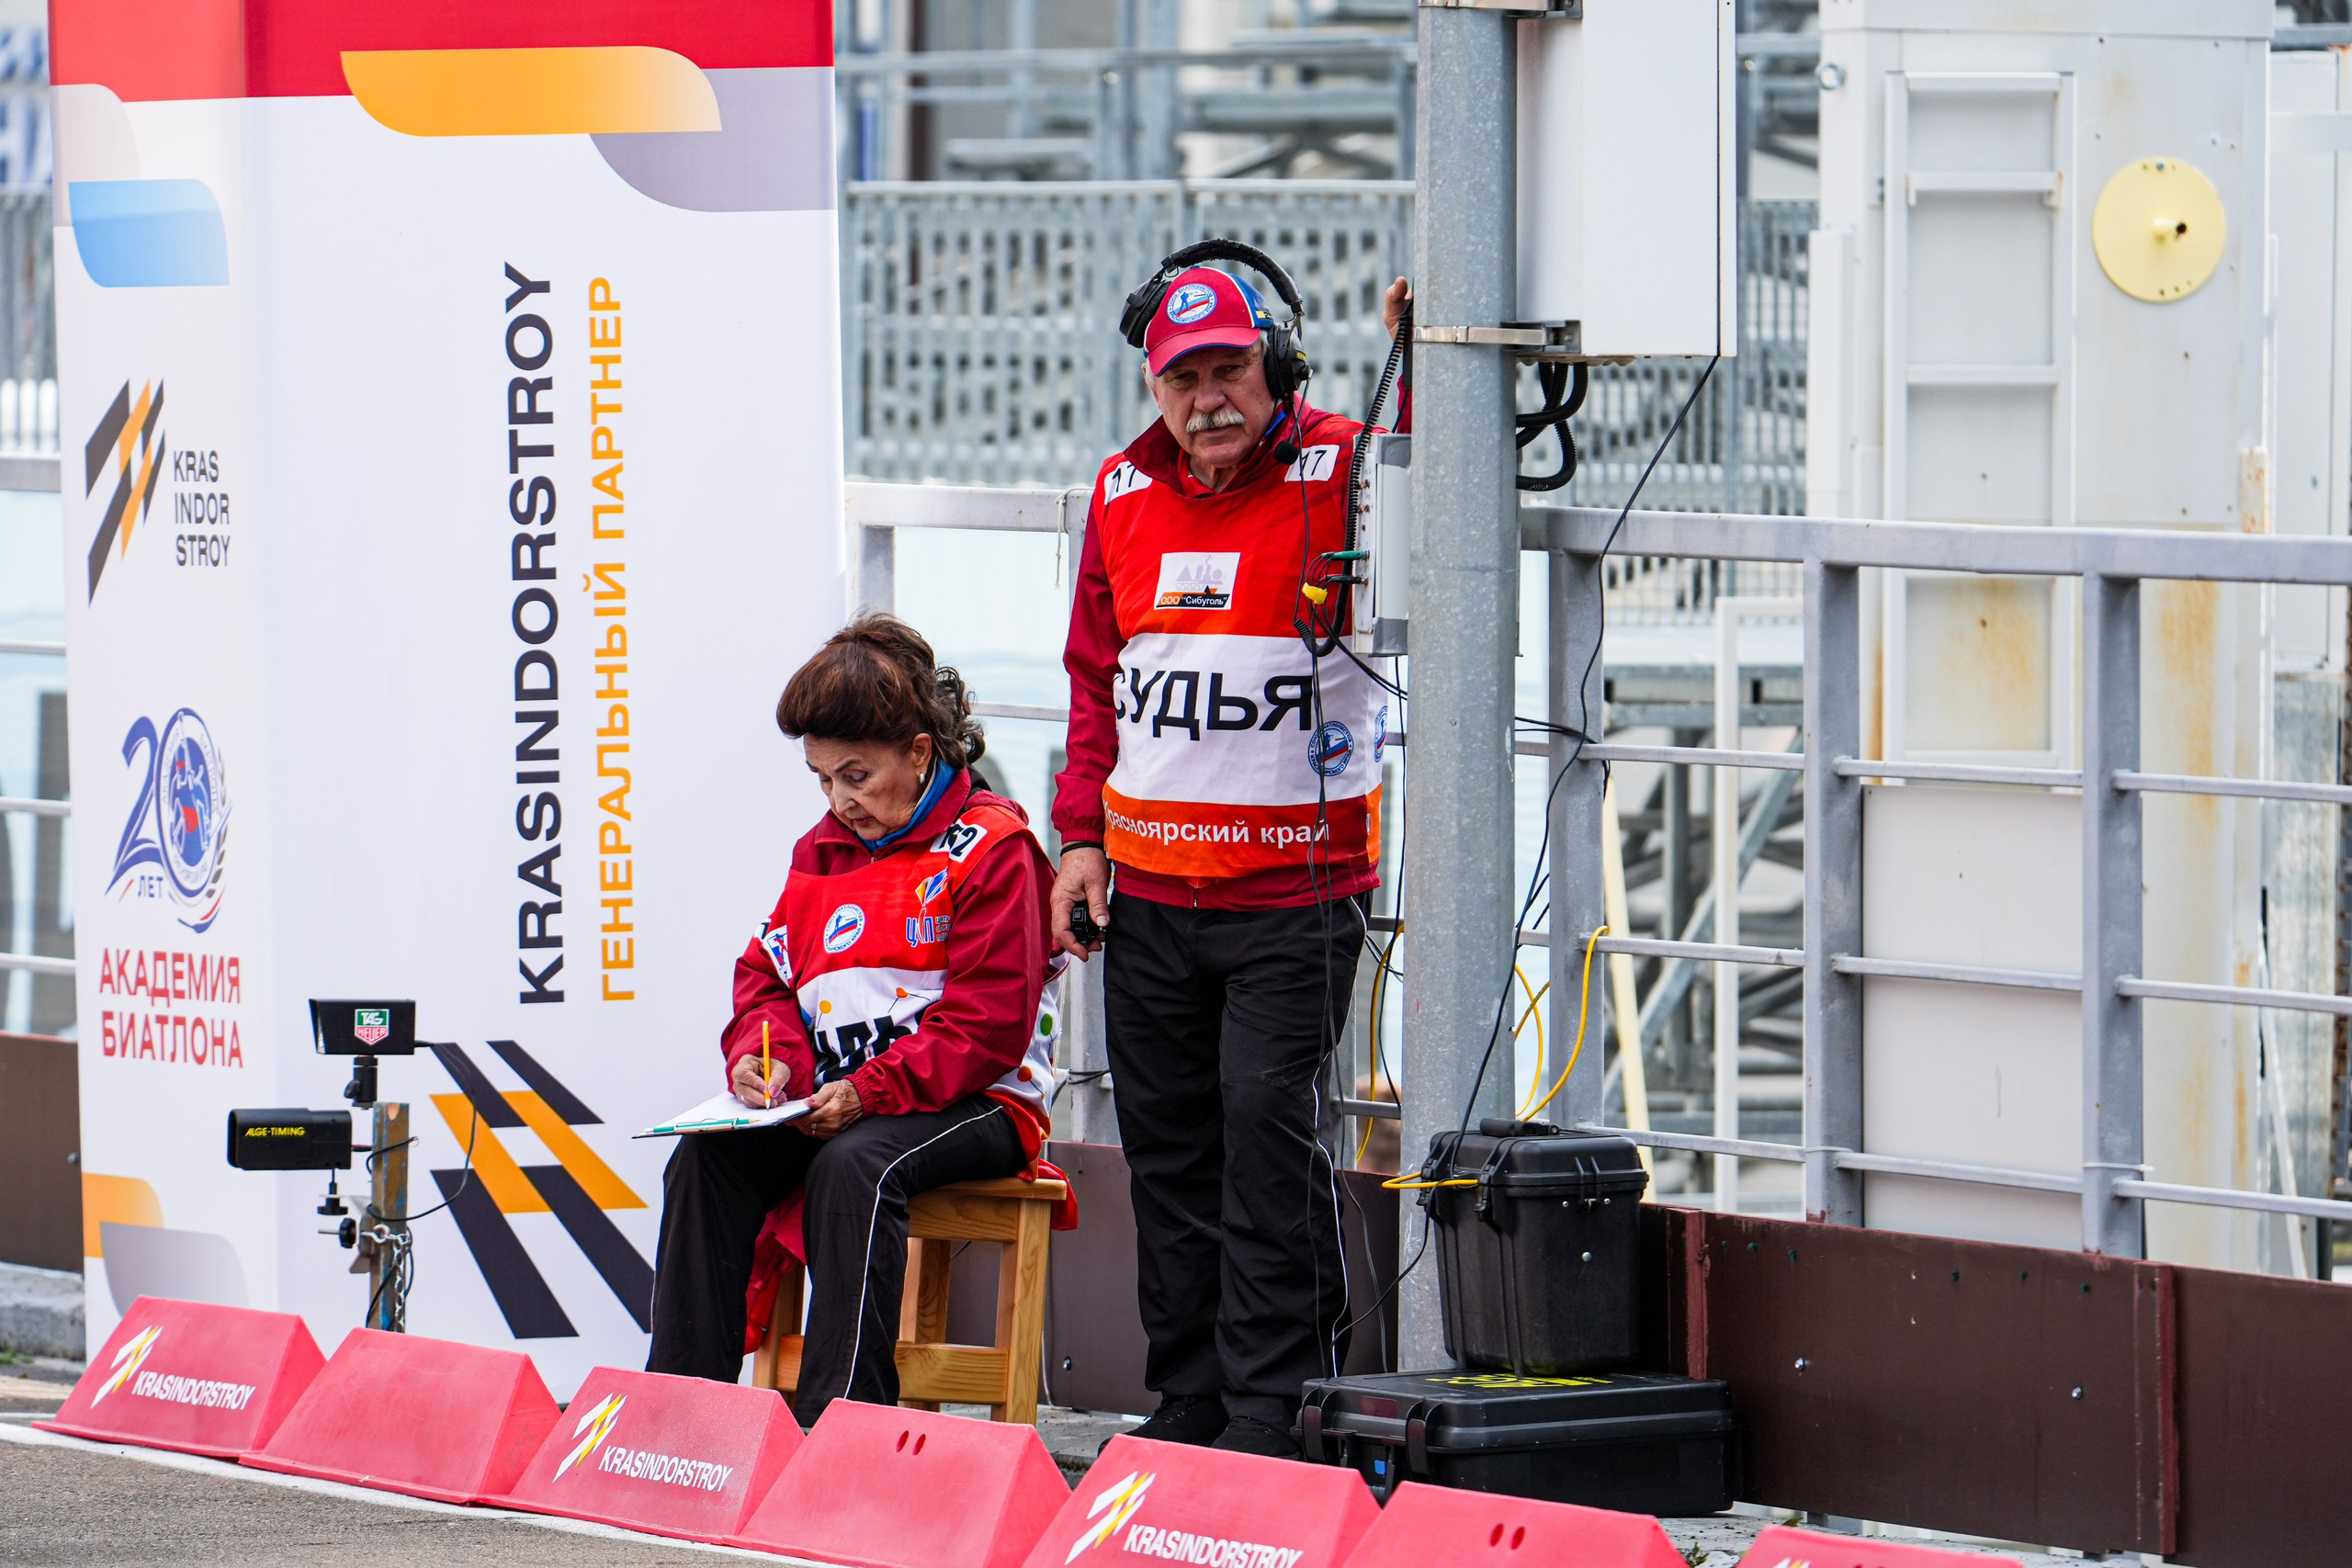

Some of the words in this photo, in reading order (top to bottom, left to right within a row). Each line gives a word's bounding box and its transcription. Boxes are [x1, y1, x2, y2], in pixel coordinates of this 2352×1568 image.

[589, 276, 627, 539] ПАРТНЕР
[174, 450, 219, 483] KRAS
[1112, 464, 1136, 492] 17
[1299, 450, 1327, 477] 17
[175, 492, 230, 525] INDOR
[176, 534, 230, 567] STROY
[1160, 596, 1180, 605] ООО
[504, 262, 565, 1004] KRASINDORSTROY
[582, 562, 636, 1001] ГЕНЕРАЛЬНЫЙ
[137, 875, 164, 898] ЛЕТ
[99, 947, 242, 1009] АКАДЕМИЯ
[357, 1027, 387, 1041] HEUER
[360, 1011, 384, 1025] TAG
[102, 1010, 243, 1068] БИАТЛОНА
[244, 1126, 306, 1137] ALGE-TIMING
[131, 1370, 256, 1411] KRASINDORSTROY
[598, 1445, 734, 1493] KRASINDORSTROY
[1123, 1523, 1305, 1568] KRASINDORSTROY
